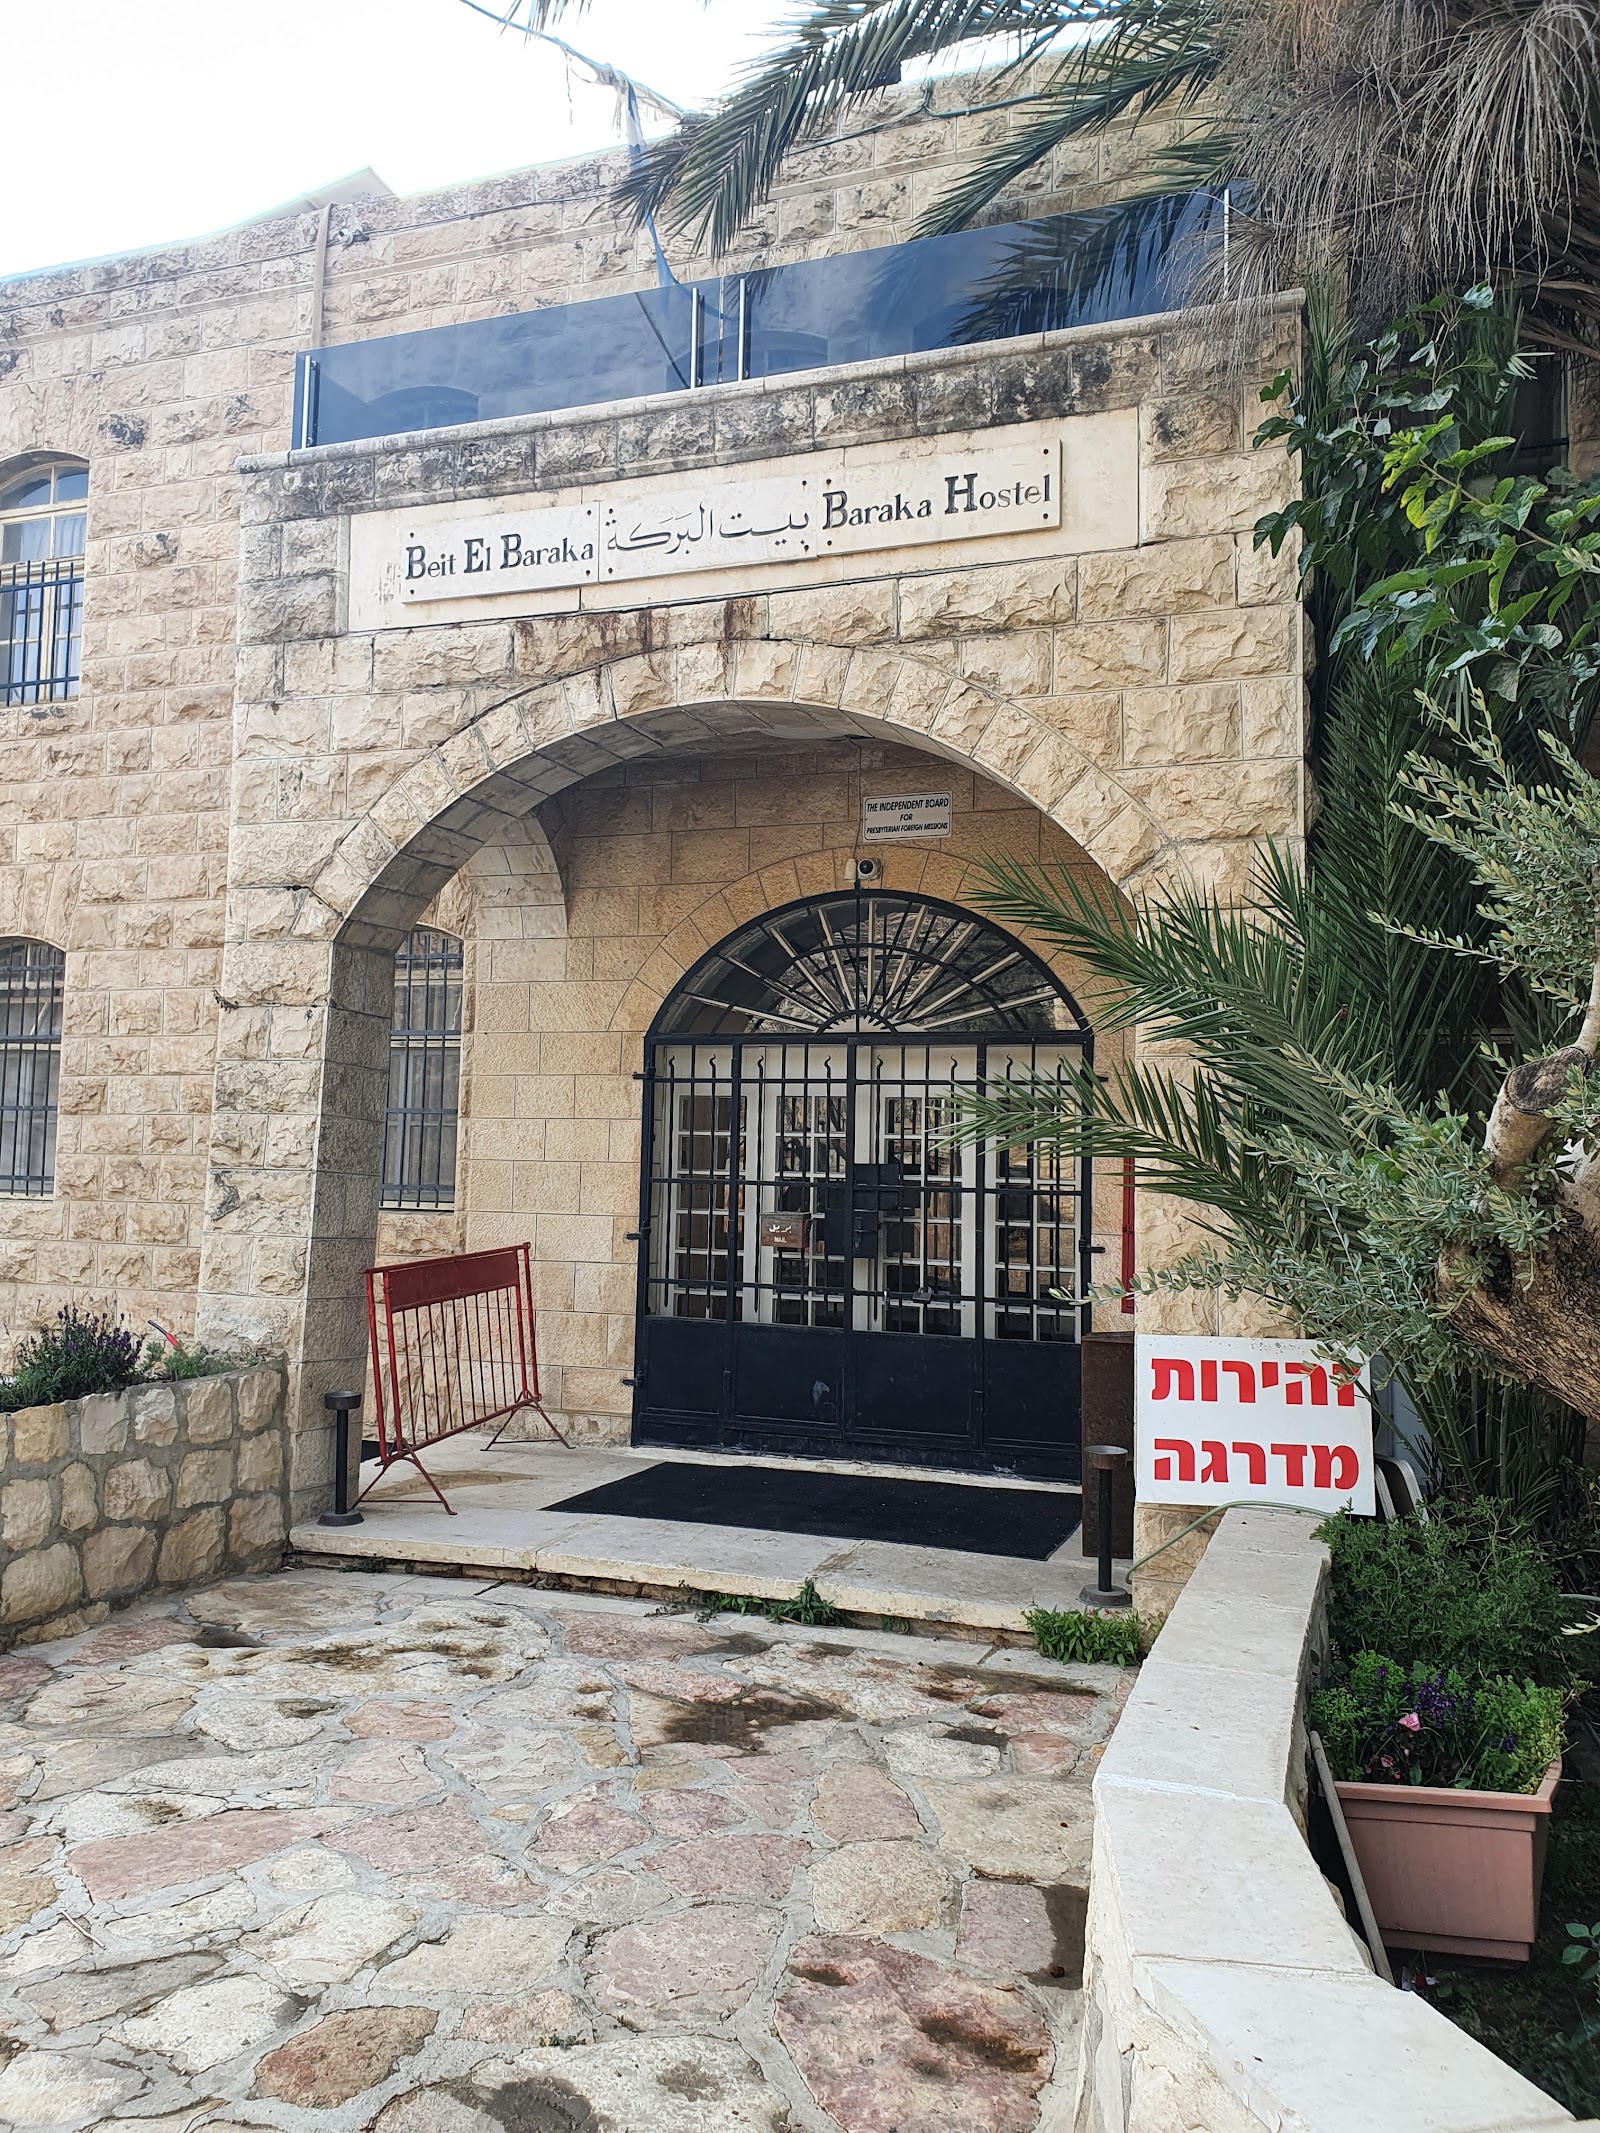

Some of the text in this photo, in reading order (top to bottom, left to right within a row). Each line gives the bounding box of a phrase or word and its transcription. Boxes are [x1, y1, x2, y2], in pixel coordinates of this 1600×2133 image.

[822, 472, 1052, 530] Baraka Hostel
[719, 511, 810, 546] بيت
[405, 533, 593, 580] Beit El Baraka
[867, 798, 949, 812] THE INDEPENDENT BOARD
[900, 813, 913, 821] FOR
[866, 822, 948, 834] PRESBYTERIAN FOREIGN MISSIONS
[1154, 1438, 1359, 1490] מדרגה
